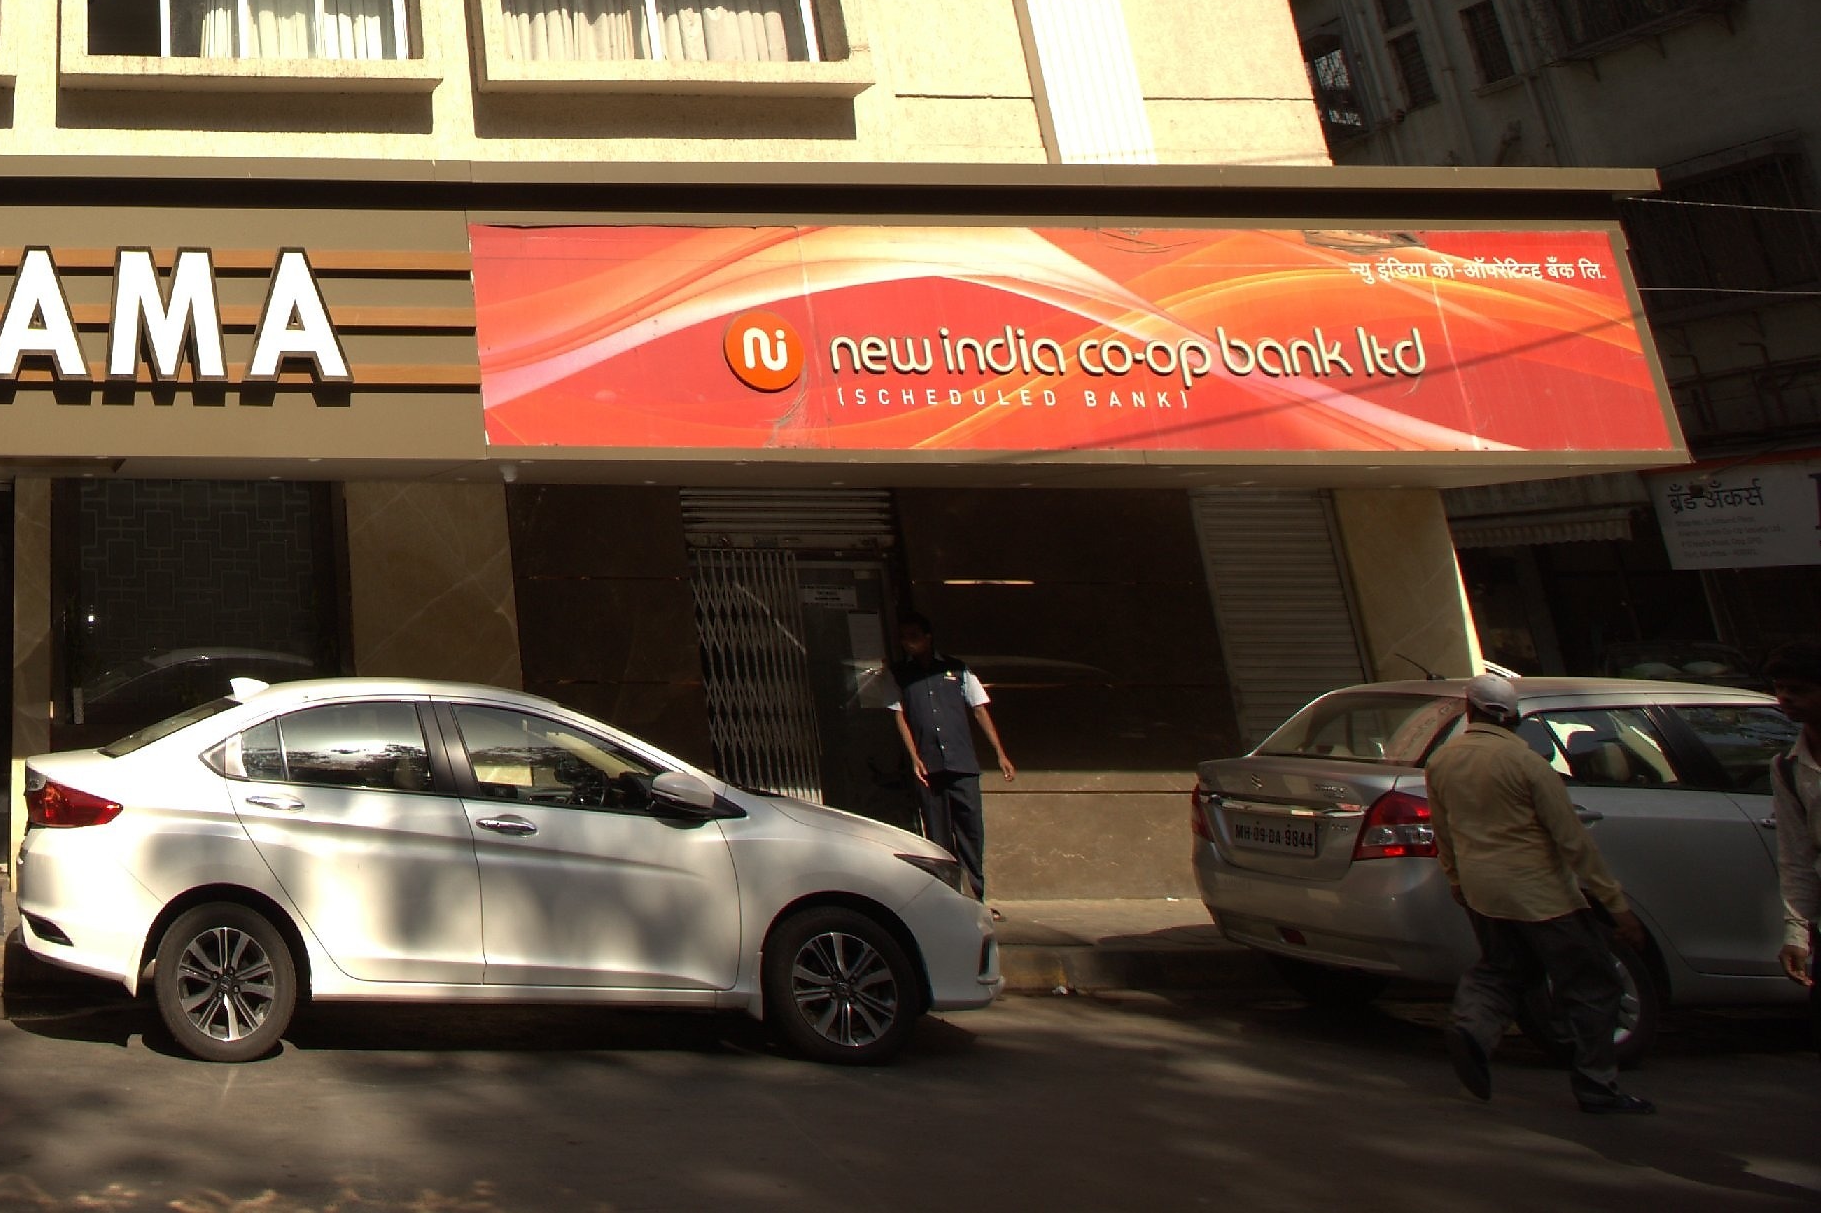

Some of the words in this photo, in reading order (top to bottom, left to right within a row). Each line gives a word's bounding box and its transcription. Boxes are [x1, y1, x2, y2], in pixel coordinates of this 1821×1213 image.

[1376, 257, 1427, 282] इंडिया
[830, 336, 932, 375] new
[939, 324, 1067, 376] india
[1077, 338, 1212, 390] co-op
[1216, 325, 1354, 377] bank
[1355, 325, 1428, 377] ltd
